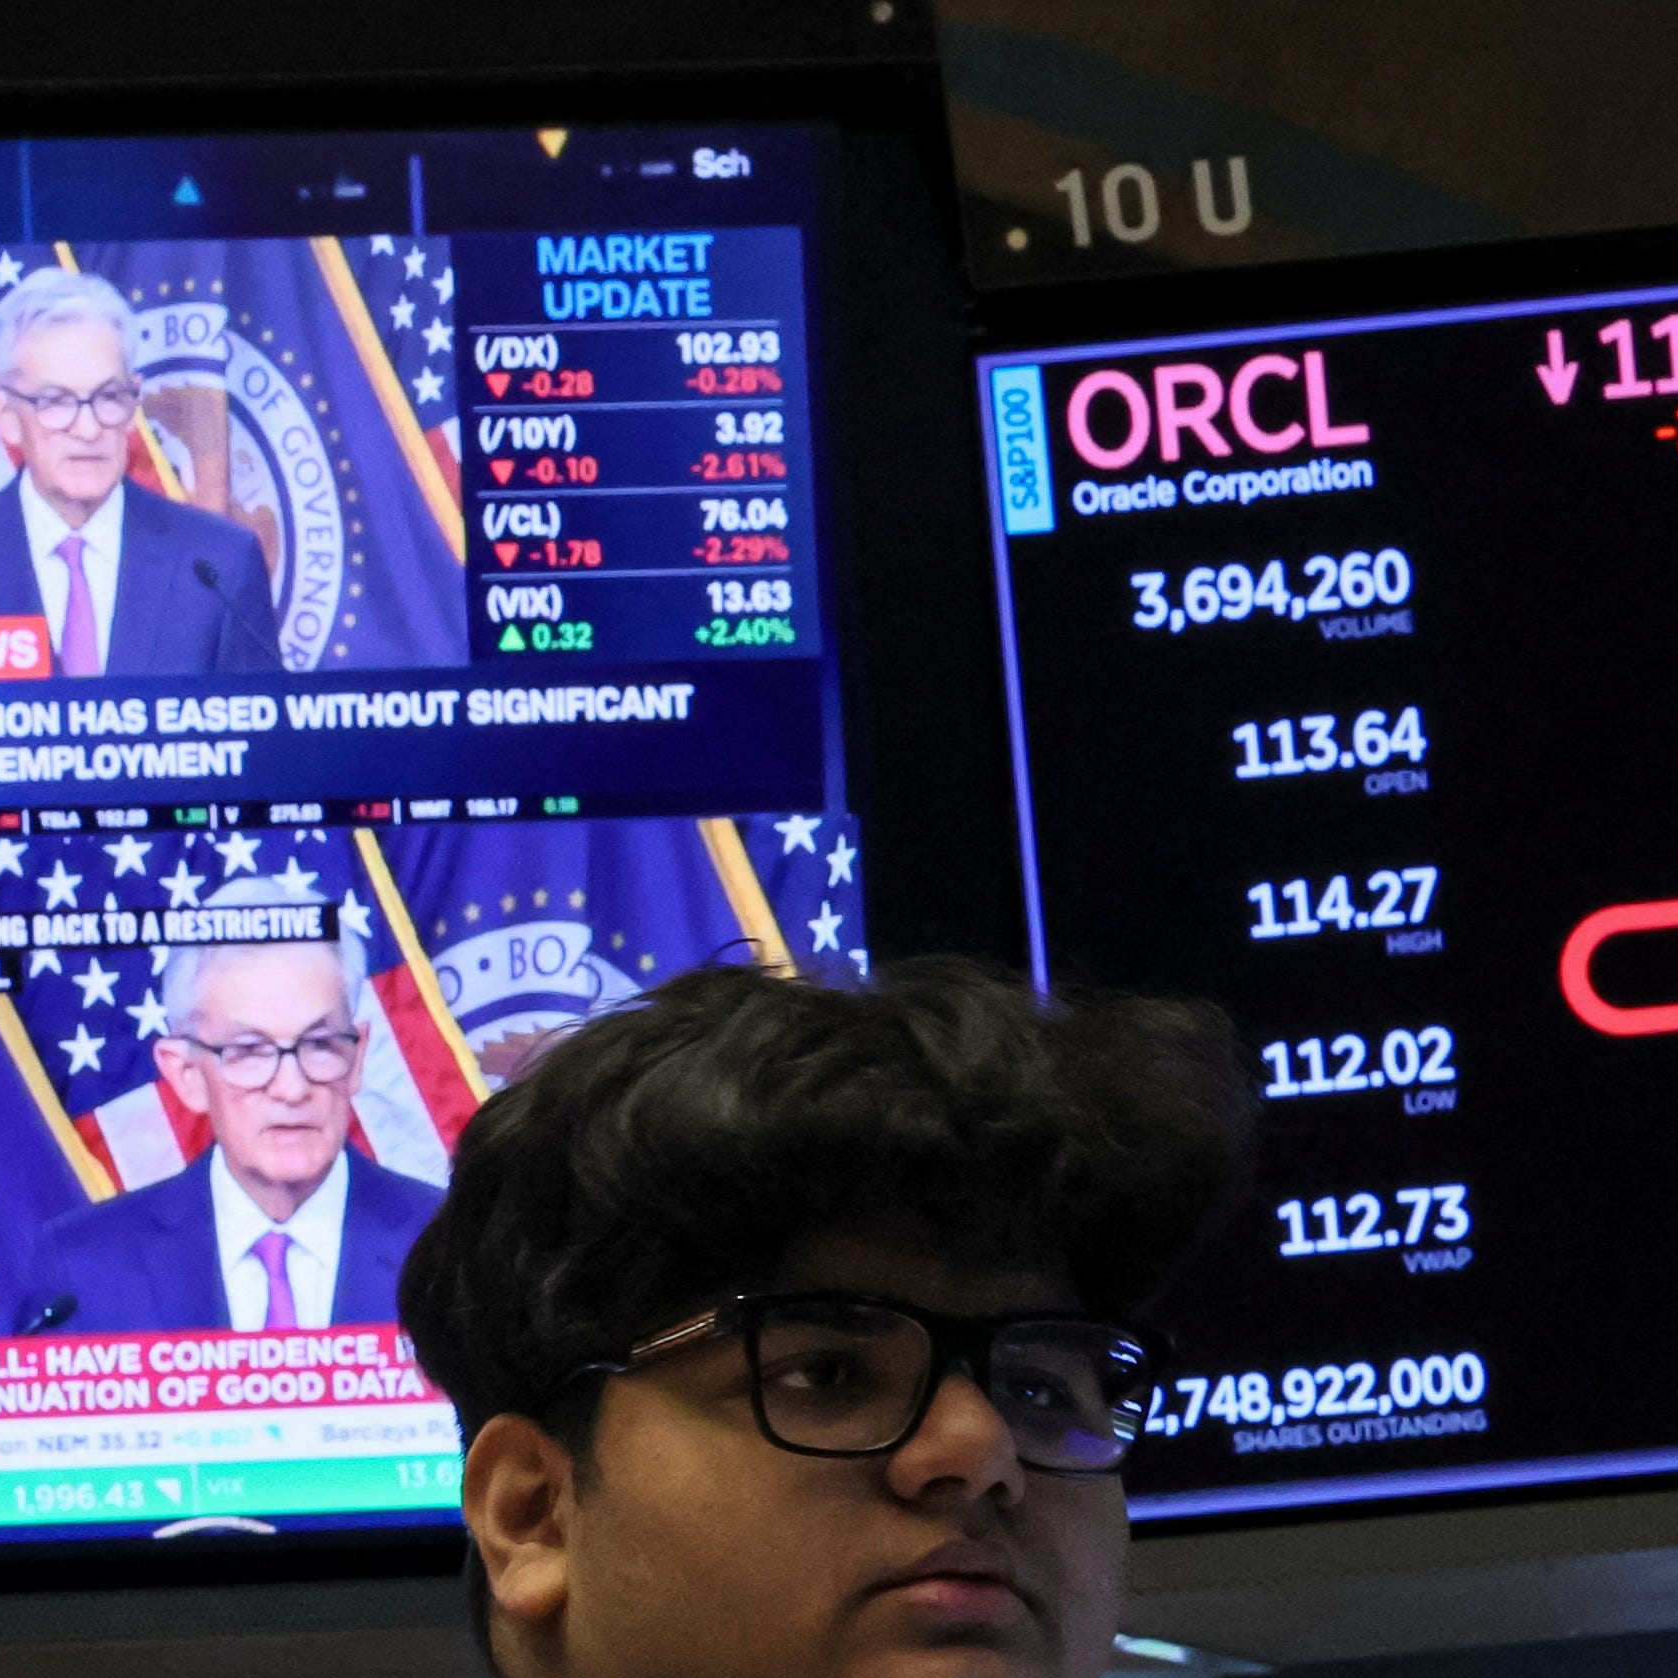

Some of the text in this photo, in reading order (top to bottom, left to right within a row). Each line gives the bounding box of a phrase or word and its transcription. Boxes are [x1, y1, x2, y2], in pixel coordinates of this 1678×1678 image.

[693, 148, 750, 178] Sch
[1055, 156, 1251, 248] 10 U
[537, 233, 713, 274] MARKET
[543, 278, 712, 319] UPDATE
[677, 331, 779, 363] 102.93
[715, 412, 784, 444] 3.92
[1066, 350, 1369, 470] ORCL
[526, 456, 598, 482] -0.10
[1004, 387, 1039, 511] S&P100
[1073, 458, 1373, 515] Oracle Corporation
[700, 498, 787, 530] 76.04
[487, 584, 562, 622] (VIX)
[1131, 548, 1411, 633] 3,694,260
[533, 623, 593, 650] 0.32
[1319, 609, 1413, 641] VOLUME
[68, 700, 147, 735] HAS
[156, 696, 278, 734] EASED
[286, 691, 459, 730] WITHOUT
[467, 684, 694, 724] SIGNIFICANT
[1232, 706, 1427, 778] 113.64
[1364, 770, 1427, 796] OPEN
[1247, 865, 1438, 939] 114.27
[33, 913, 101, 946] BACK
[103, 912, 137, 944] TO
[141, 911, 160, 942] A
[164, 906, 323, 941] RESTRICTIVE
[1386, 929, 1442, 956] HIGH
[1262, 1025, 1456, 1097] 112.02
[1404, 1088, 1457, 1114] LOW
[1277, 1184, 1469, 1256] 112.73
[1402, 1247, 1473, 1274] VWAP
[46, 1343, 142, 1377] HAVE
[149, 1333, 388, 1373] CONFIDENCE,
[157, 1375, 208, 1408] OF
[216, 1370, 324, 1405] GOOD
[332, 1367, 425, 1400] DATA
[1235, 1409, 1487, 1454] SHARES OUTSTANDING
